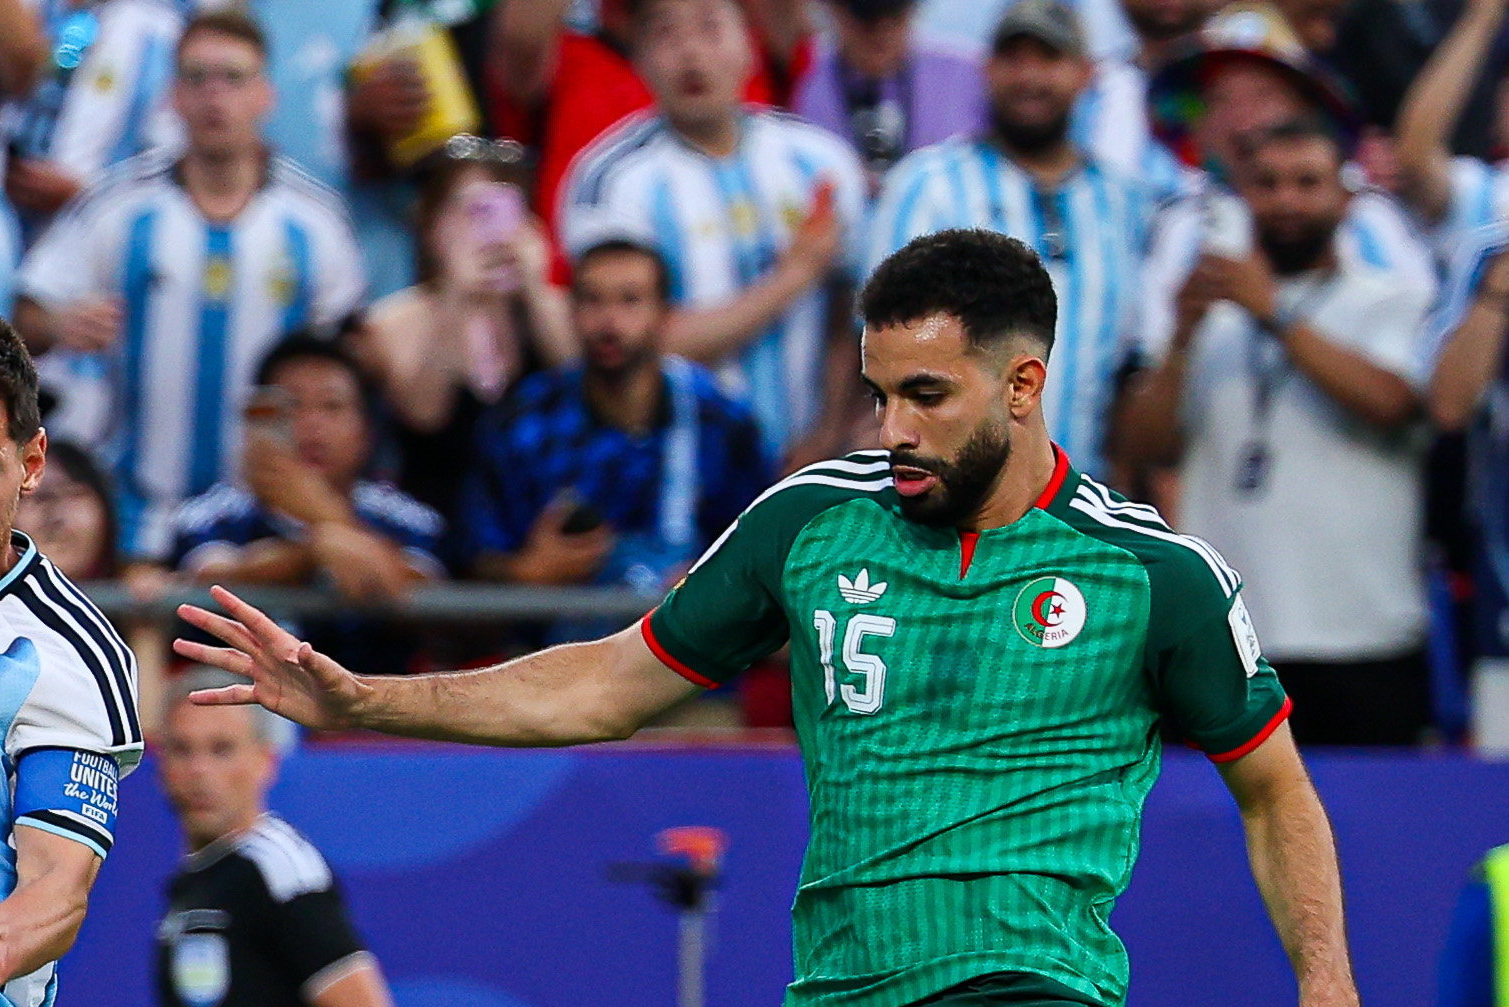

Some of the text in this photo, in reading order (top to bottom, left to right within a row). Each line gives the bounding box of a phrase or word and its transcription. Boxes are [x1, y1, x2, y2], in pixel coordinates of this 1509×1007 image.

[1024, 622, 1068, 641] ALGERIA
[813, 609, 896, 715] 15
[63, 782, 90, 800] the
[84, 806, 106, 820] FIFA
